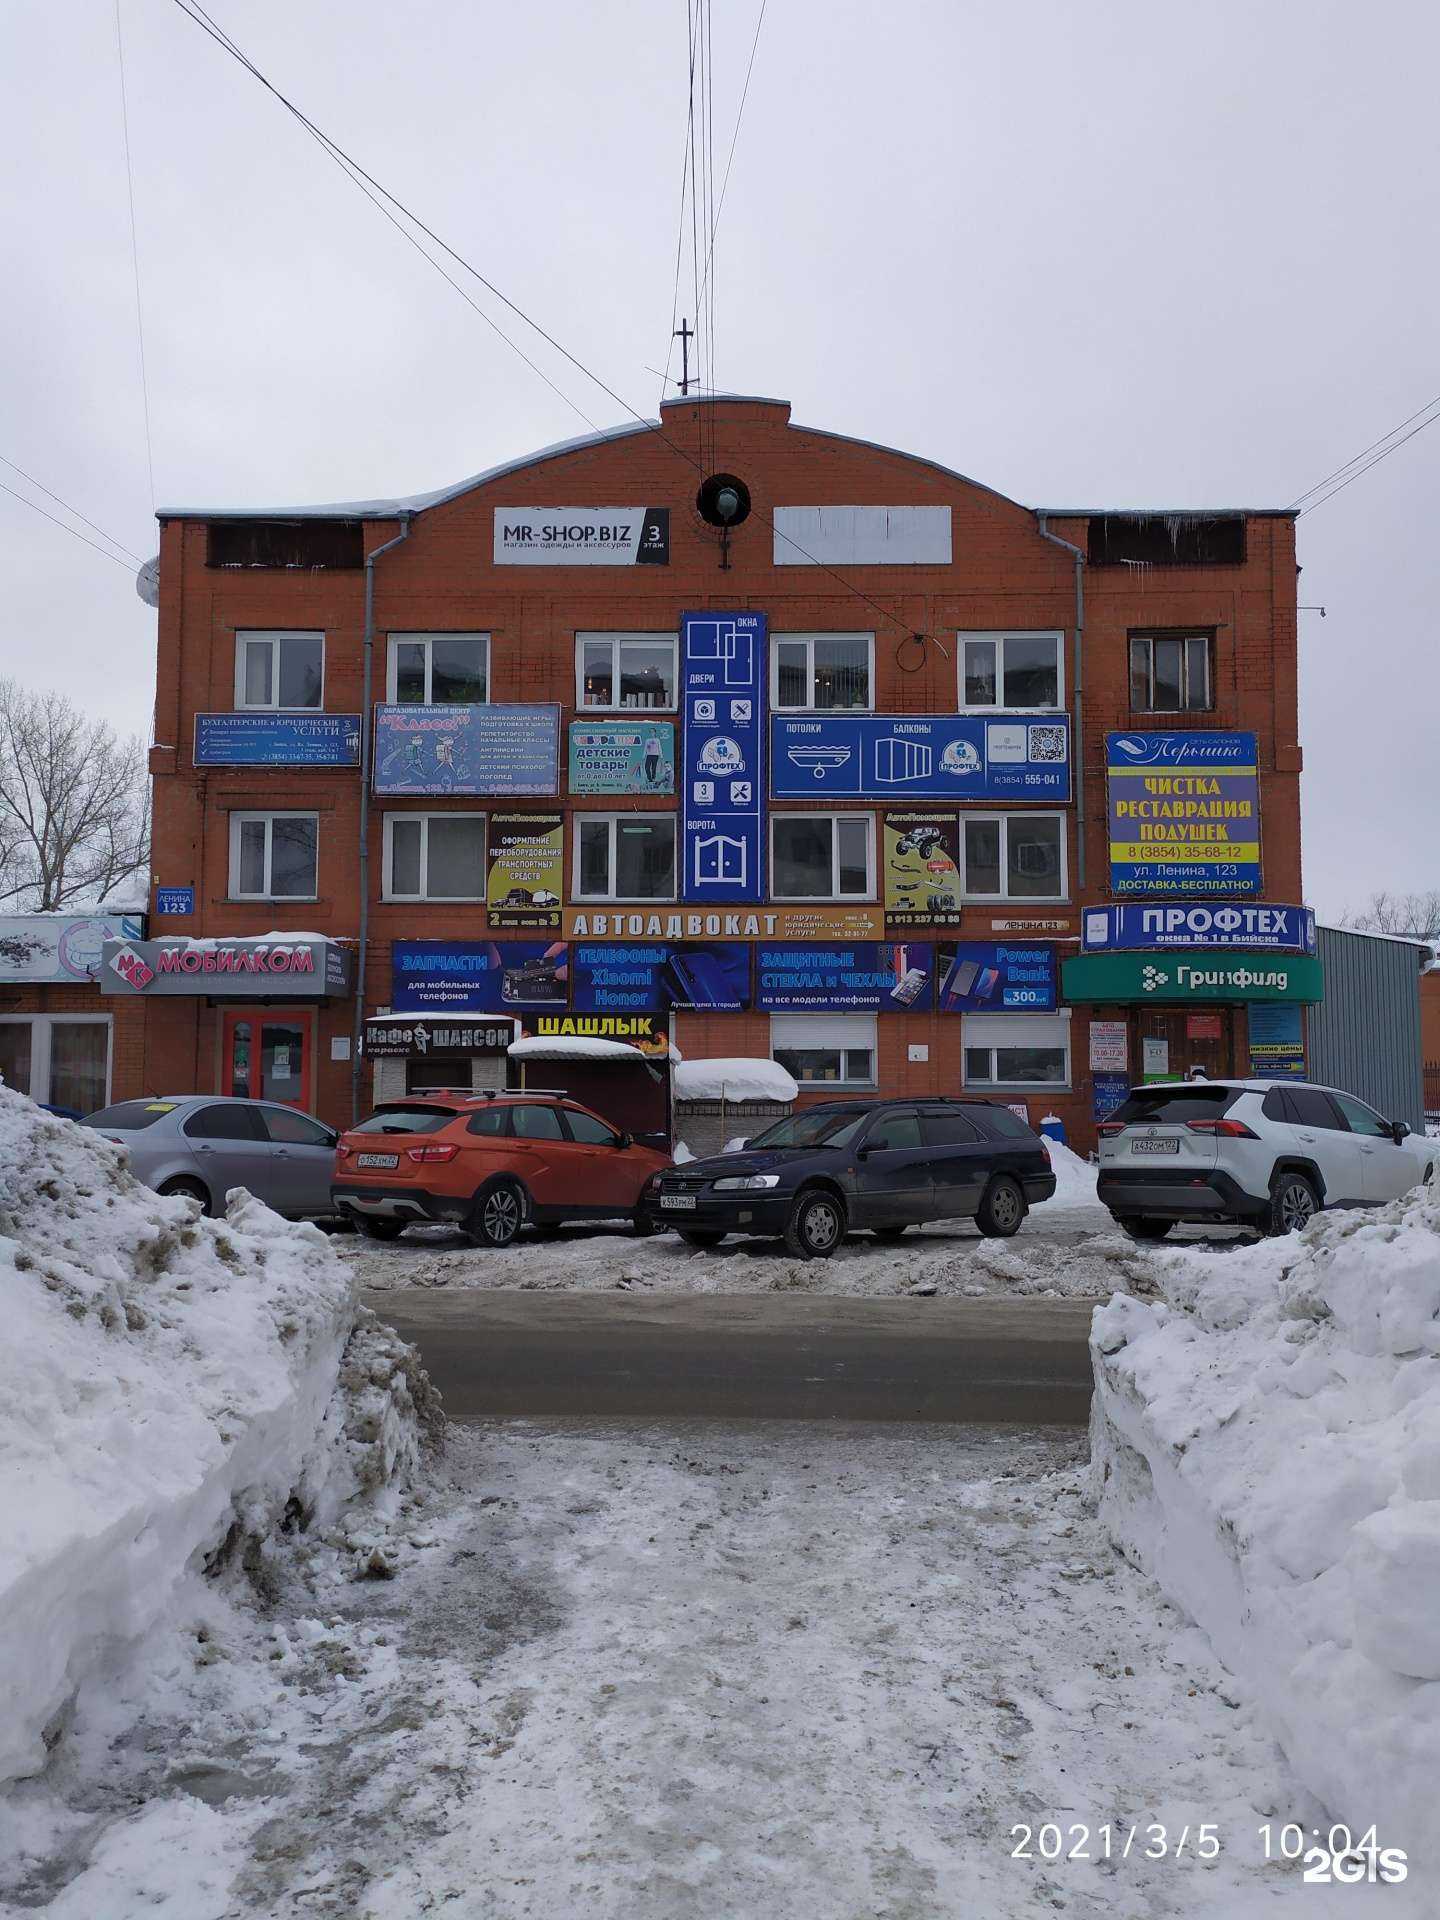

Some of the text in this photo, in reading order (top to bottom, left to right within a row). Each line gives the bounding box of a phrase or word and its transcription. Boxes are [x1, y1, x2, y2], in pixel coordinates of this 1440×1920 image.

[503, 525, 632, 542] MR-SHOP.BIZ
[648, 526, 660, 541] 3
[540, 542, 575, 550] одежды
[737, 618, 758, 627] ОКНА
[689, 674, 715, 684] ДВЕРИ
[202, 719, 270, 727] БУХГАЛТЕРСКИЕ
[276, 719, 340, 727] ЮРИДИЧЕСКИЕ
[786, 723, 822, 733] ПОТОЛКИ
[292, 727, 339, 736] УСЛУГИ
[893, 724, 931, 734] БАЛКОНЫ
[576, 749, 630, 759] детские
[579, 761, 628, 772] товары
[1025, 774, 1060, 784] 555-041
[701, 784, 707, 795] 3
[1145, 778, 1221, 795] ЧИСТКА
[1116, 801, 1252, 818] РЕСТАВРАЦИЯ
[687, 821, 716, 830] ВОРОТА
[1140, 824, 1228, 841] ПОДУШЕК
[502, 837, 550, 845] ОФОРМЛЕНИЕ
[490, 848, 562, 857] ПЕРЕОБОРУДОВАНИЯ
[1129, 846, 1241, 860] 8 (3854) 35-68-12
[497, 860, 553, 868] ТРАНСПОРТНЫХ
[509, 872, 541, 880] СРЕДСТВ
[1134, 865, 1238, 878] ул. Ленина, 123
[1118, 880, 1253, 891] ДОСТАВКА-БЕСПЛАТНО!
[159, 895, 191, 903] ЛЕНИНА
[163, 903, 186, 913] 123
[490, 912, 500, 926] 2
[550, 912, 559, 926] 3
[1142, 908, 1289, 934] ПРОФТЕХ
[572, 914, 779, 938] АВТОАДВОКАТ
[1004, 921, 1058, 930] ЛЕНИНА 123
[1194, 934, 1209, 942] №
[1232, 934, 1279, 943] Бийске
[578, 949, 667, 963] ТЕЛЕФОНЫ
[761, 952, 855, 968] ЗАЩИТНЫЕ
[996, 948, 1050, 962] Power
[156, 949, 315, 973] МОБИЛКОМ
[401, 955, 488, 971] ЗАПЧАСТИ
[591, 969, 652, 985] Xiaomi
[1007, 967, 1050, 982] Bank
[1177, 966, 1288, 990] Гринфилд
[408, 980, 480, 990] для мобильных
[761, 973, 896, 988] СТЕКЛА и ЧЕХЛЫ
[419, 992, 469, 1001] телефонов
[595, 990, 649, 1006] Honor
[830, 995, 880, 1004] телефонов
[1013, 991, 1036, 1002] 300
[538, 1017, 652, 1036] ШАШЛЫК
[366, 1027, 509, 1047] Кафе ШАНСОН
